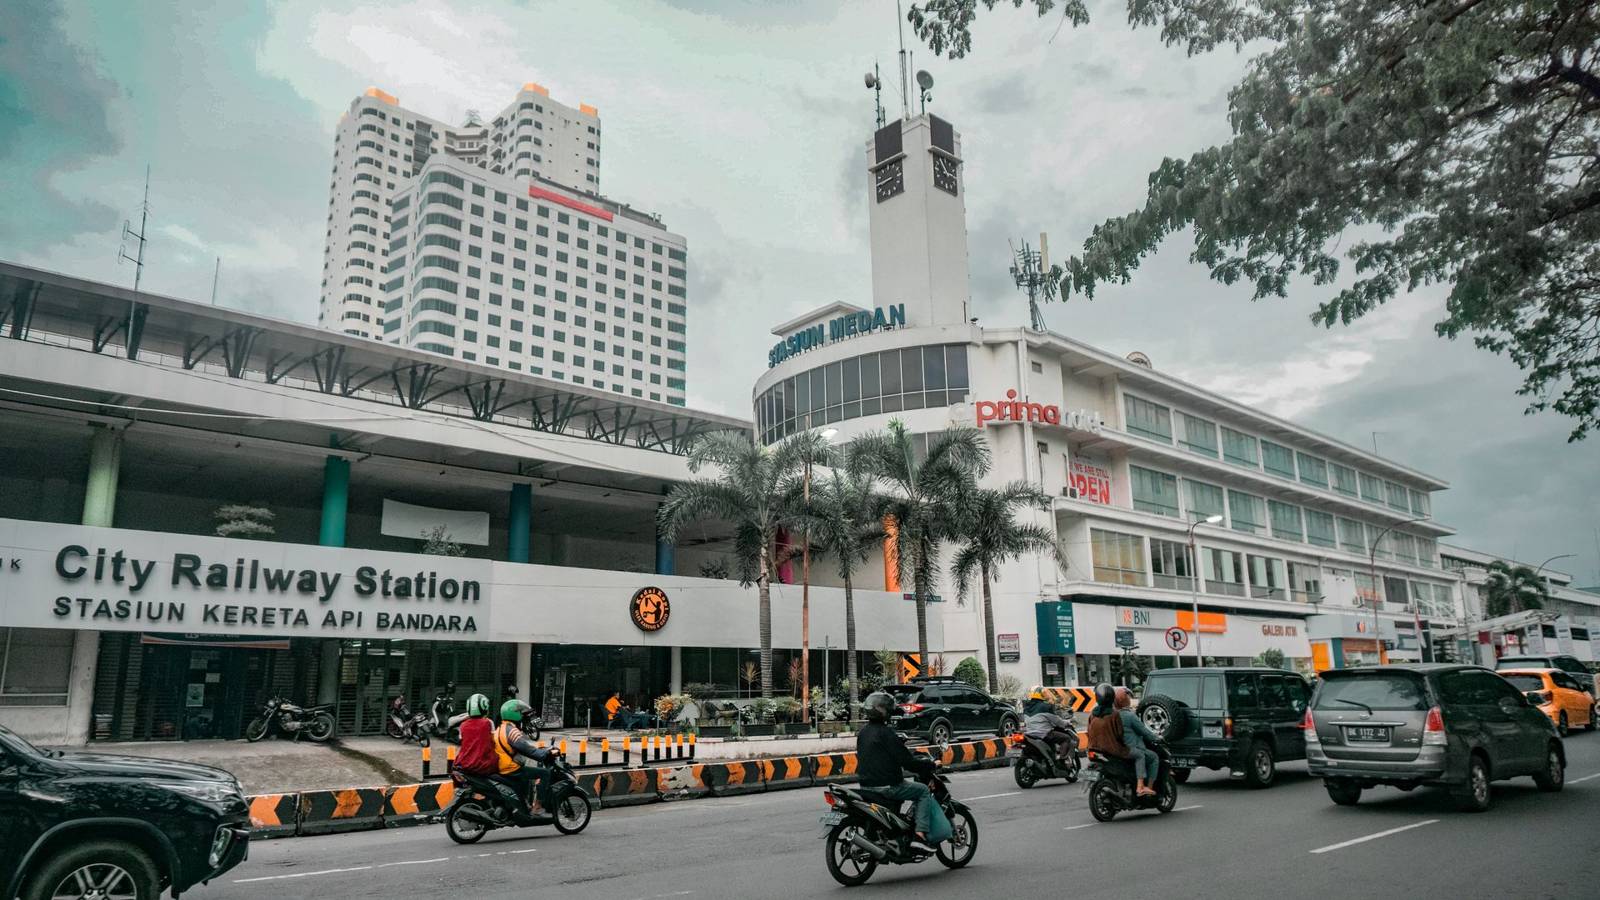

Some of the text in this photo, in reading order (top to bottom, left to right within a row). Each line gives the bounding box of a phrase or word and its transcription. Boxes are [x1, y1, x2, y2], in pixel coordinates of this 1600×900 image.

[768, 303, 906, 368] STASIUN MEDAN
[976, 388, 1061, 428] prima
[1084, 464, 1095, 476] ARE
[55, 544, 481, 602] City Railway Station
[53, 596, 477, 632] STASIUN KERETA API BANDARA
[1133, 610, 1151, 625] BNI
[1172, 631, 1181, 647] P
